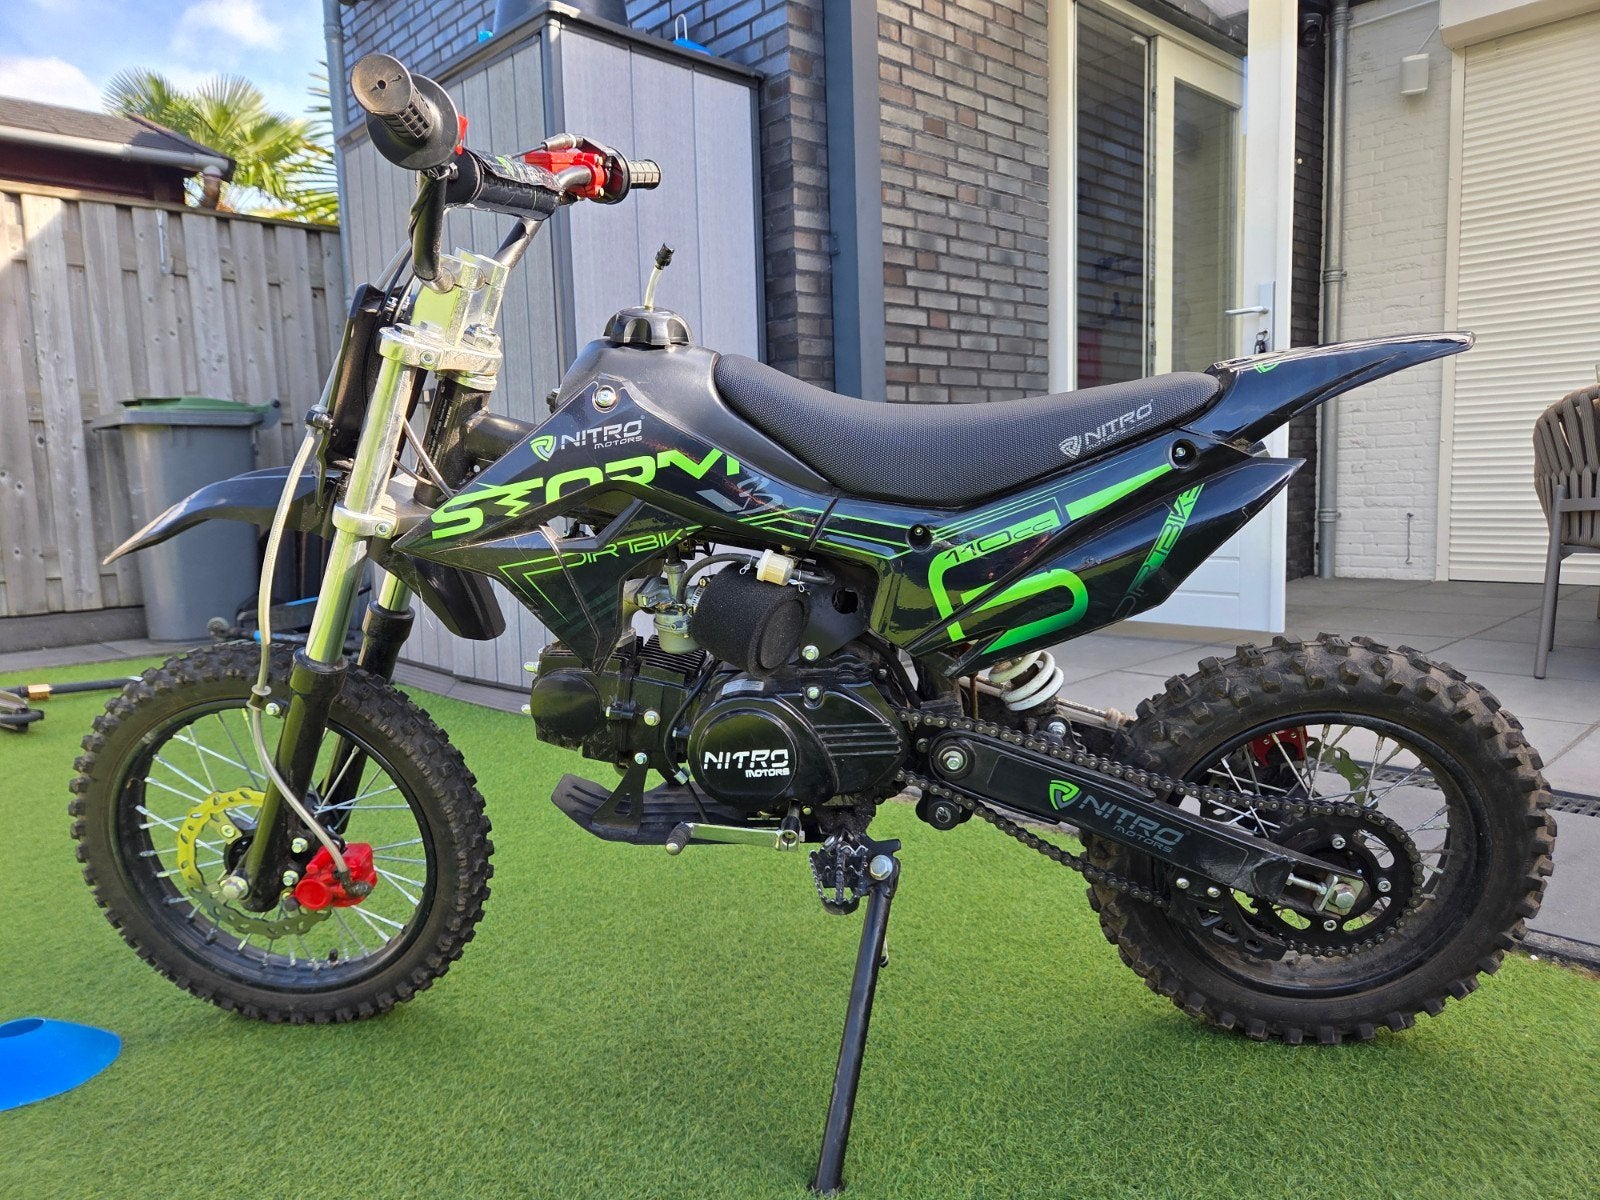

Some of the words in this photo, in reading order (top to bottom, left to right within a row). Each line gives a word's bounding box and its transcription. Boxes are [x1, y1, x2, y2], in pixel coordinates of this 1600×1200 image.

[560, 419, 642, 450] NITRO
[1084, 402, 1153, 447] NITRO
[594, 436, 643, 450] MOTORS
[431, 448, 740, 539] STORM
[944, 519, 1053, 562] 110cc
[703, 749, 789, 770] NITRO
[745, 767, 790, 778] MOTORS
[1079, 795, 1185, 846] NITRO
[1113, 825, 1174, 853] MOTORS
